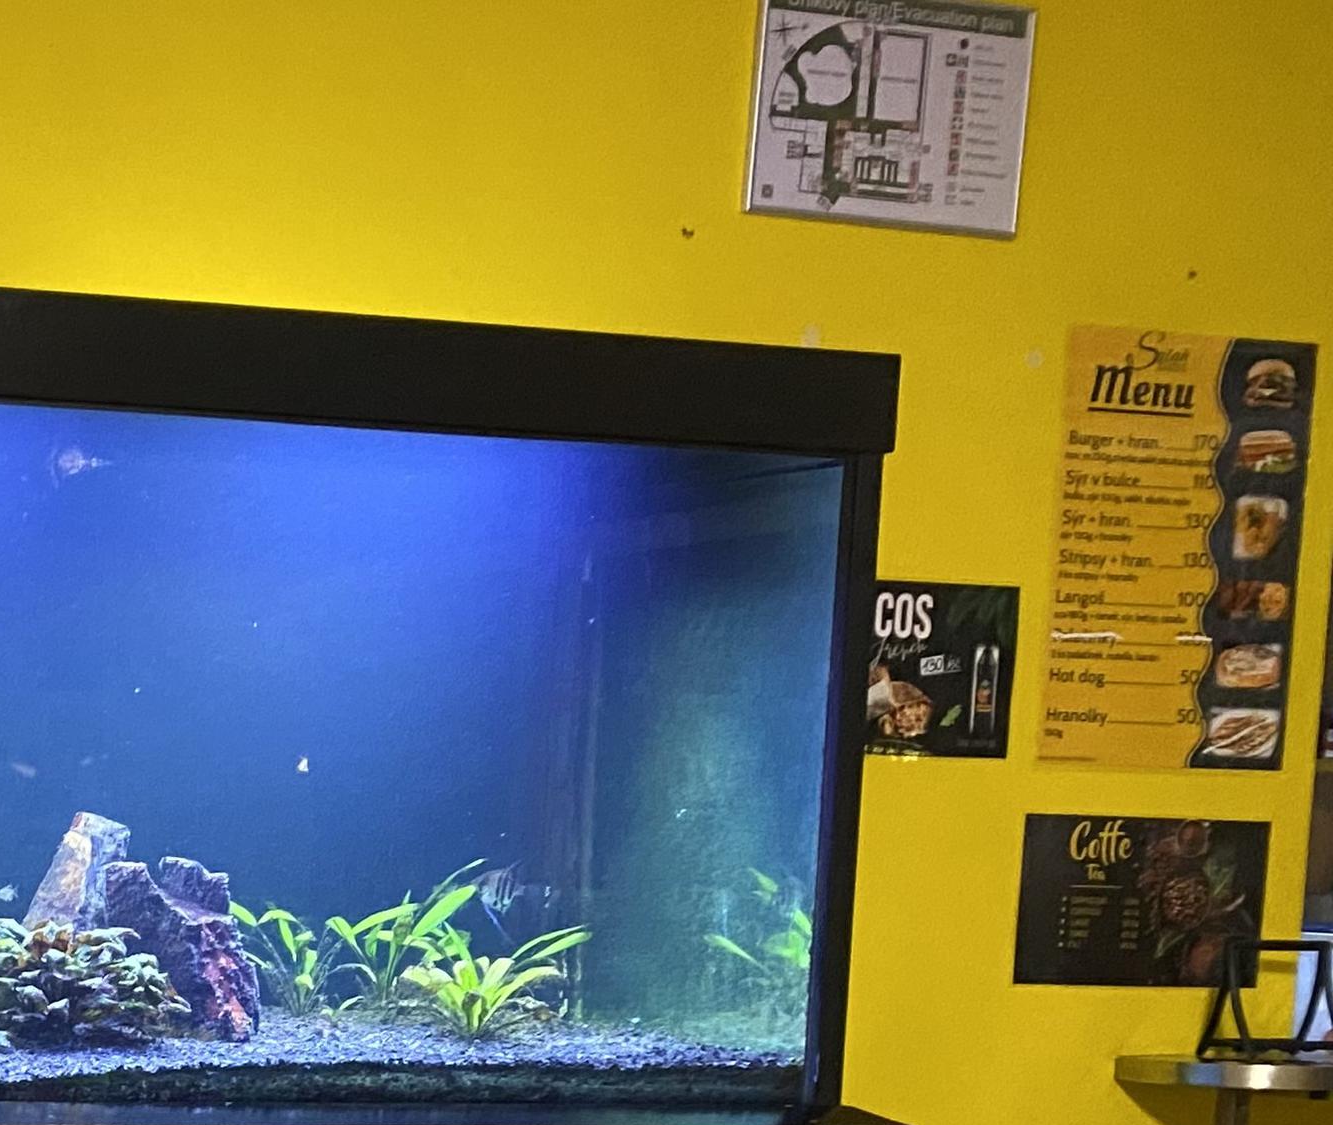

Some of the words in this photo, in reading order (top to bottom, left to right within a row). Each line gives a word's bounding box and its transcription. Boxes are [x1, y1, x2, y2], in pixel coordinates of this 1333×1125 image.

[1090, 364, 1195, 410] Menu
[1069, 429, 1114, 450] Burger
[1059, 549, 1107, 570] Stripsy
[874, 591, 934, 640] COS
[1049, 668, 1076, 684] Hot
[1078, 669, 1107, 688] dog
[1046, 708, 1108, 728] Hranolky
[1069, 820, 1133, 866] Coffe
